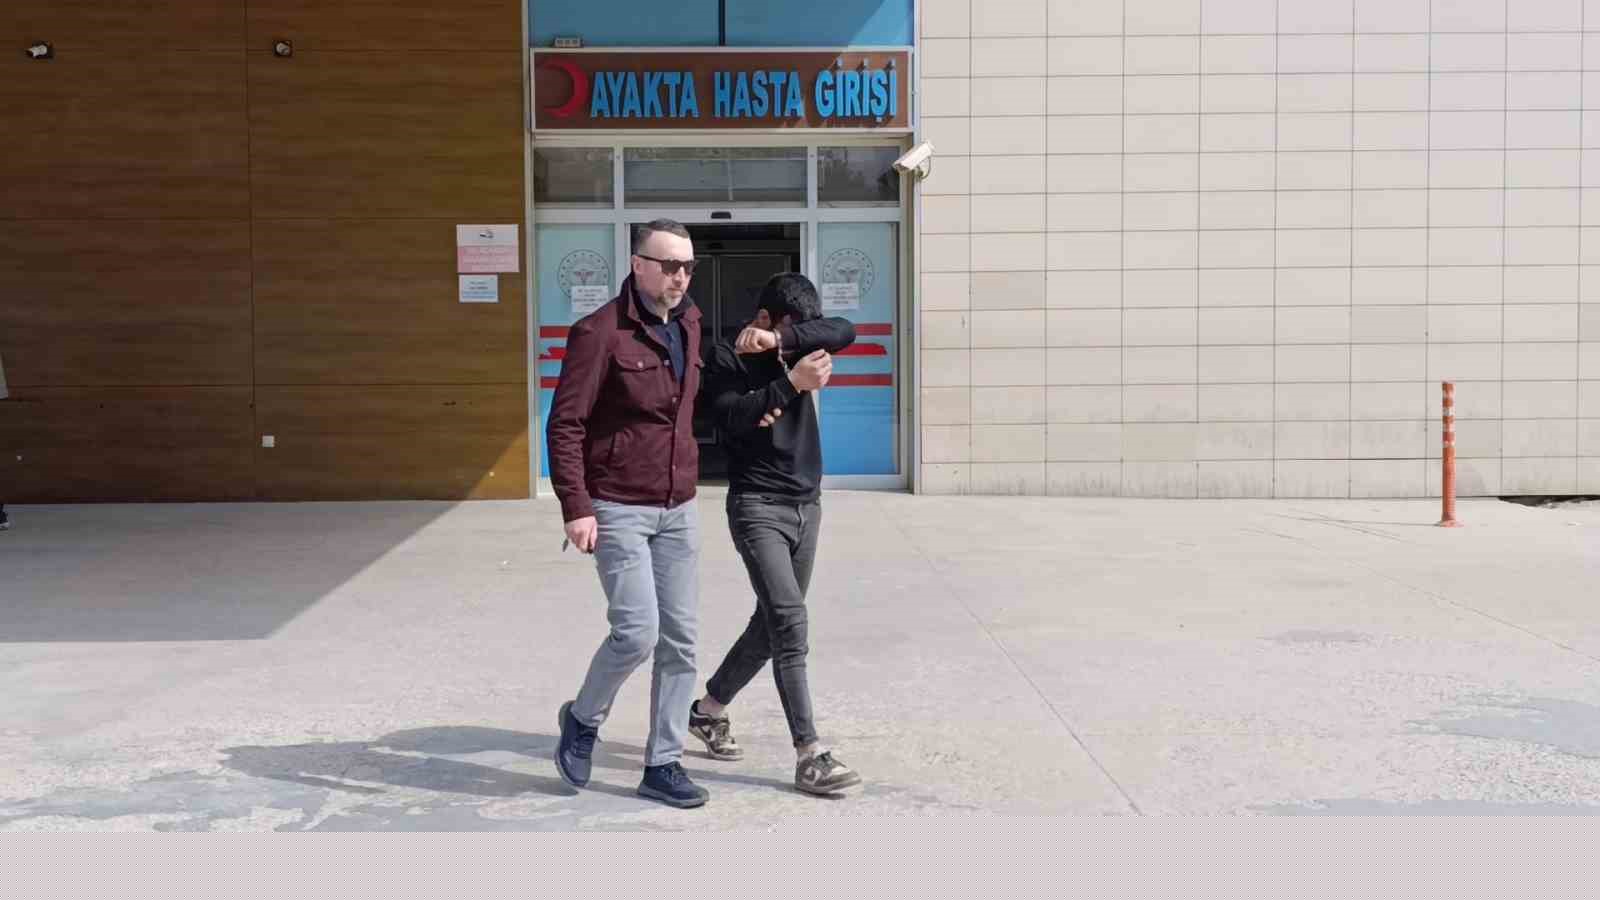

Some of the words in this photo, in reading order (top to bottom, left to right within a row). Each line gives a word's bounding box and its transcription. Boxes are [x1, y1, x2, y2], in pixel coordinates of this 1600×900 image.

[591, 71, 700, 118] AYAKTA
[714, 70, 806, 118] HASTA
[815, 57, 897, 122] GİRİŞİ
